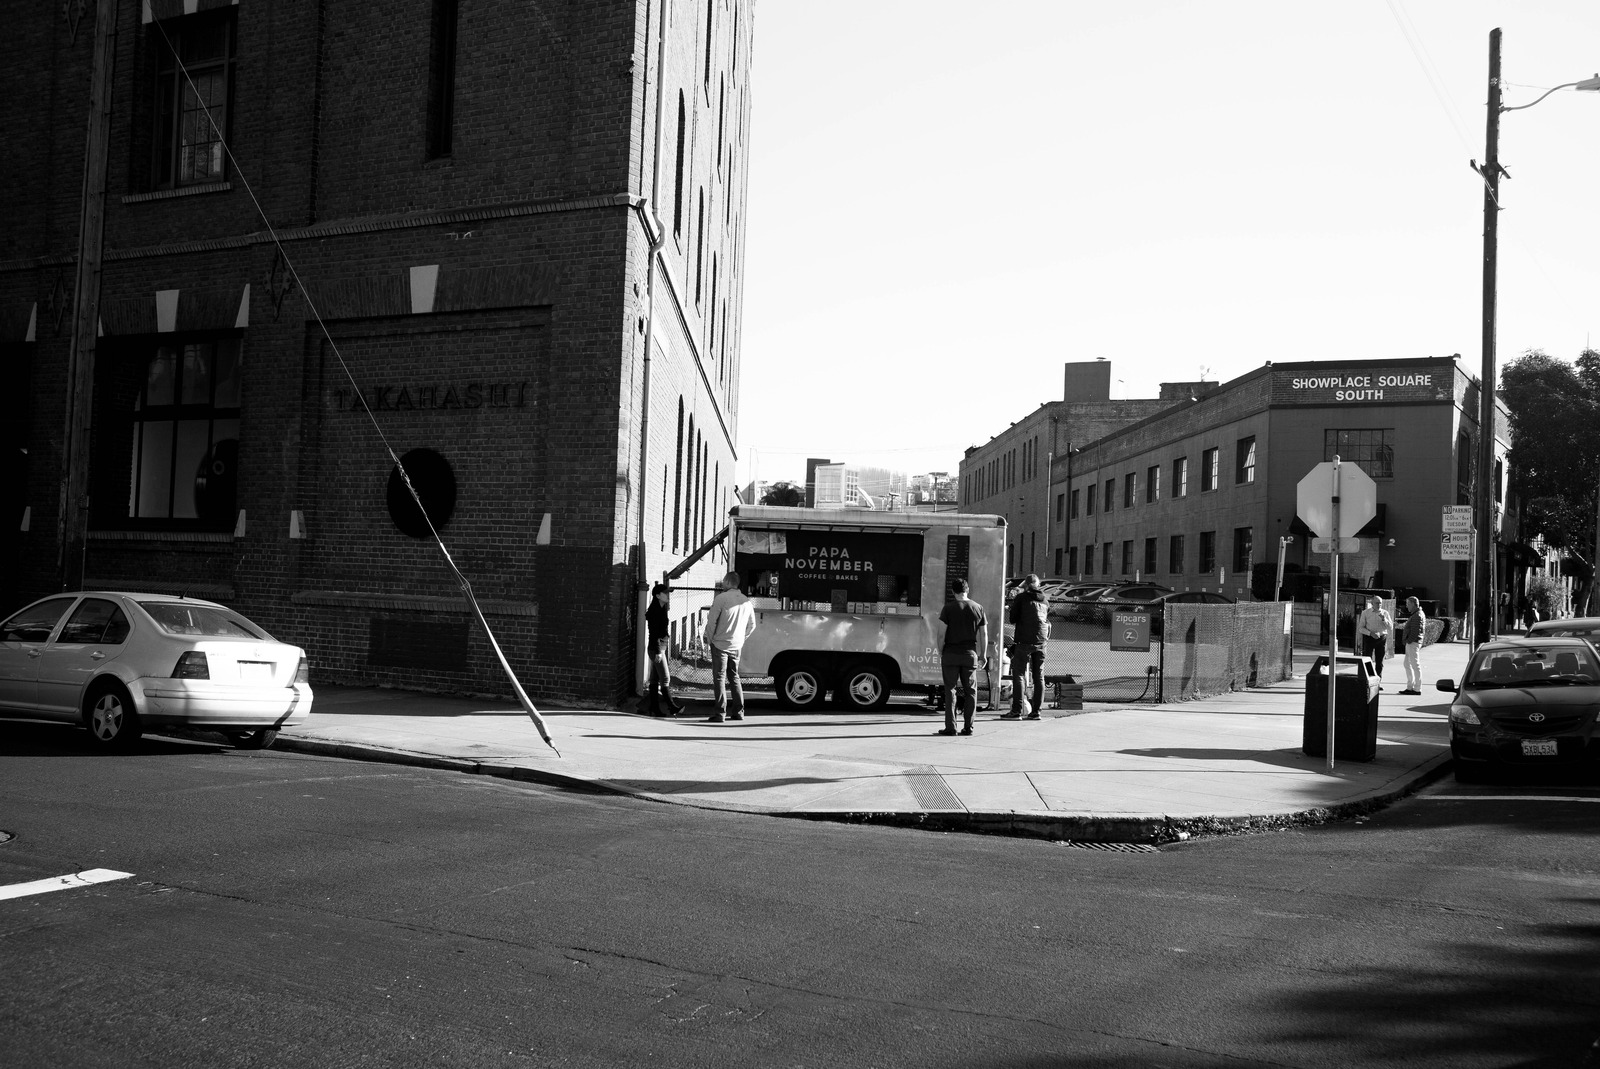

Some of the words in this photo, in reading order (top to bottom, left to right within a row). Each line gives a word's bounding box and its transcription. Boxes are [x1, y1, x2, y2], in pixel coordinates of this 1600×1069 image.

[1292, 376, 1371, 389] SHOWPLACE
[1378, 375, 1432, 387] SQUARE
[333, 381, 528, 413] TAKAHASHI
[1335, 389, 1384, 401] SOUTH
[1443, 506, 1452, 514] NO
[1442, 534, 1450, 543] 2
[809, 546, 850, 559] PAPA
[785, 558, 874, 572] NOVEMBER
[1115, 613, 1147, 624] zipcars
[925, 647, 939, 655] PA
[908, 654, 942, 664] NOVE
